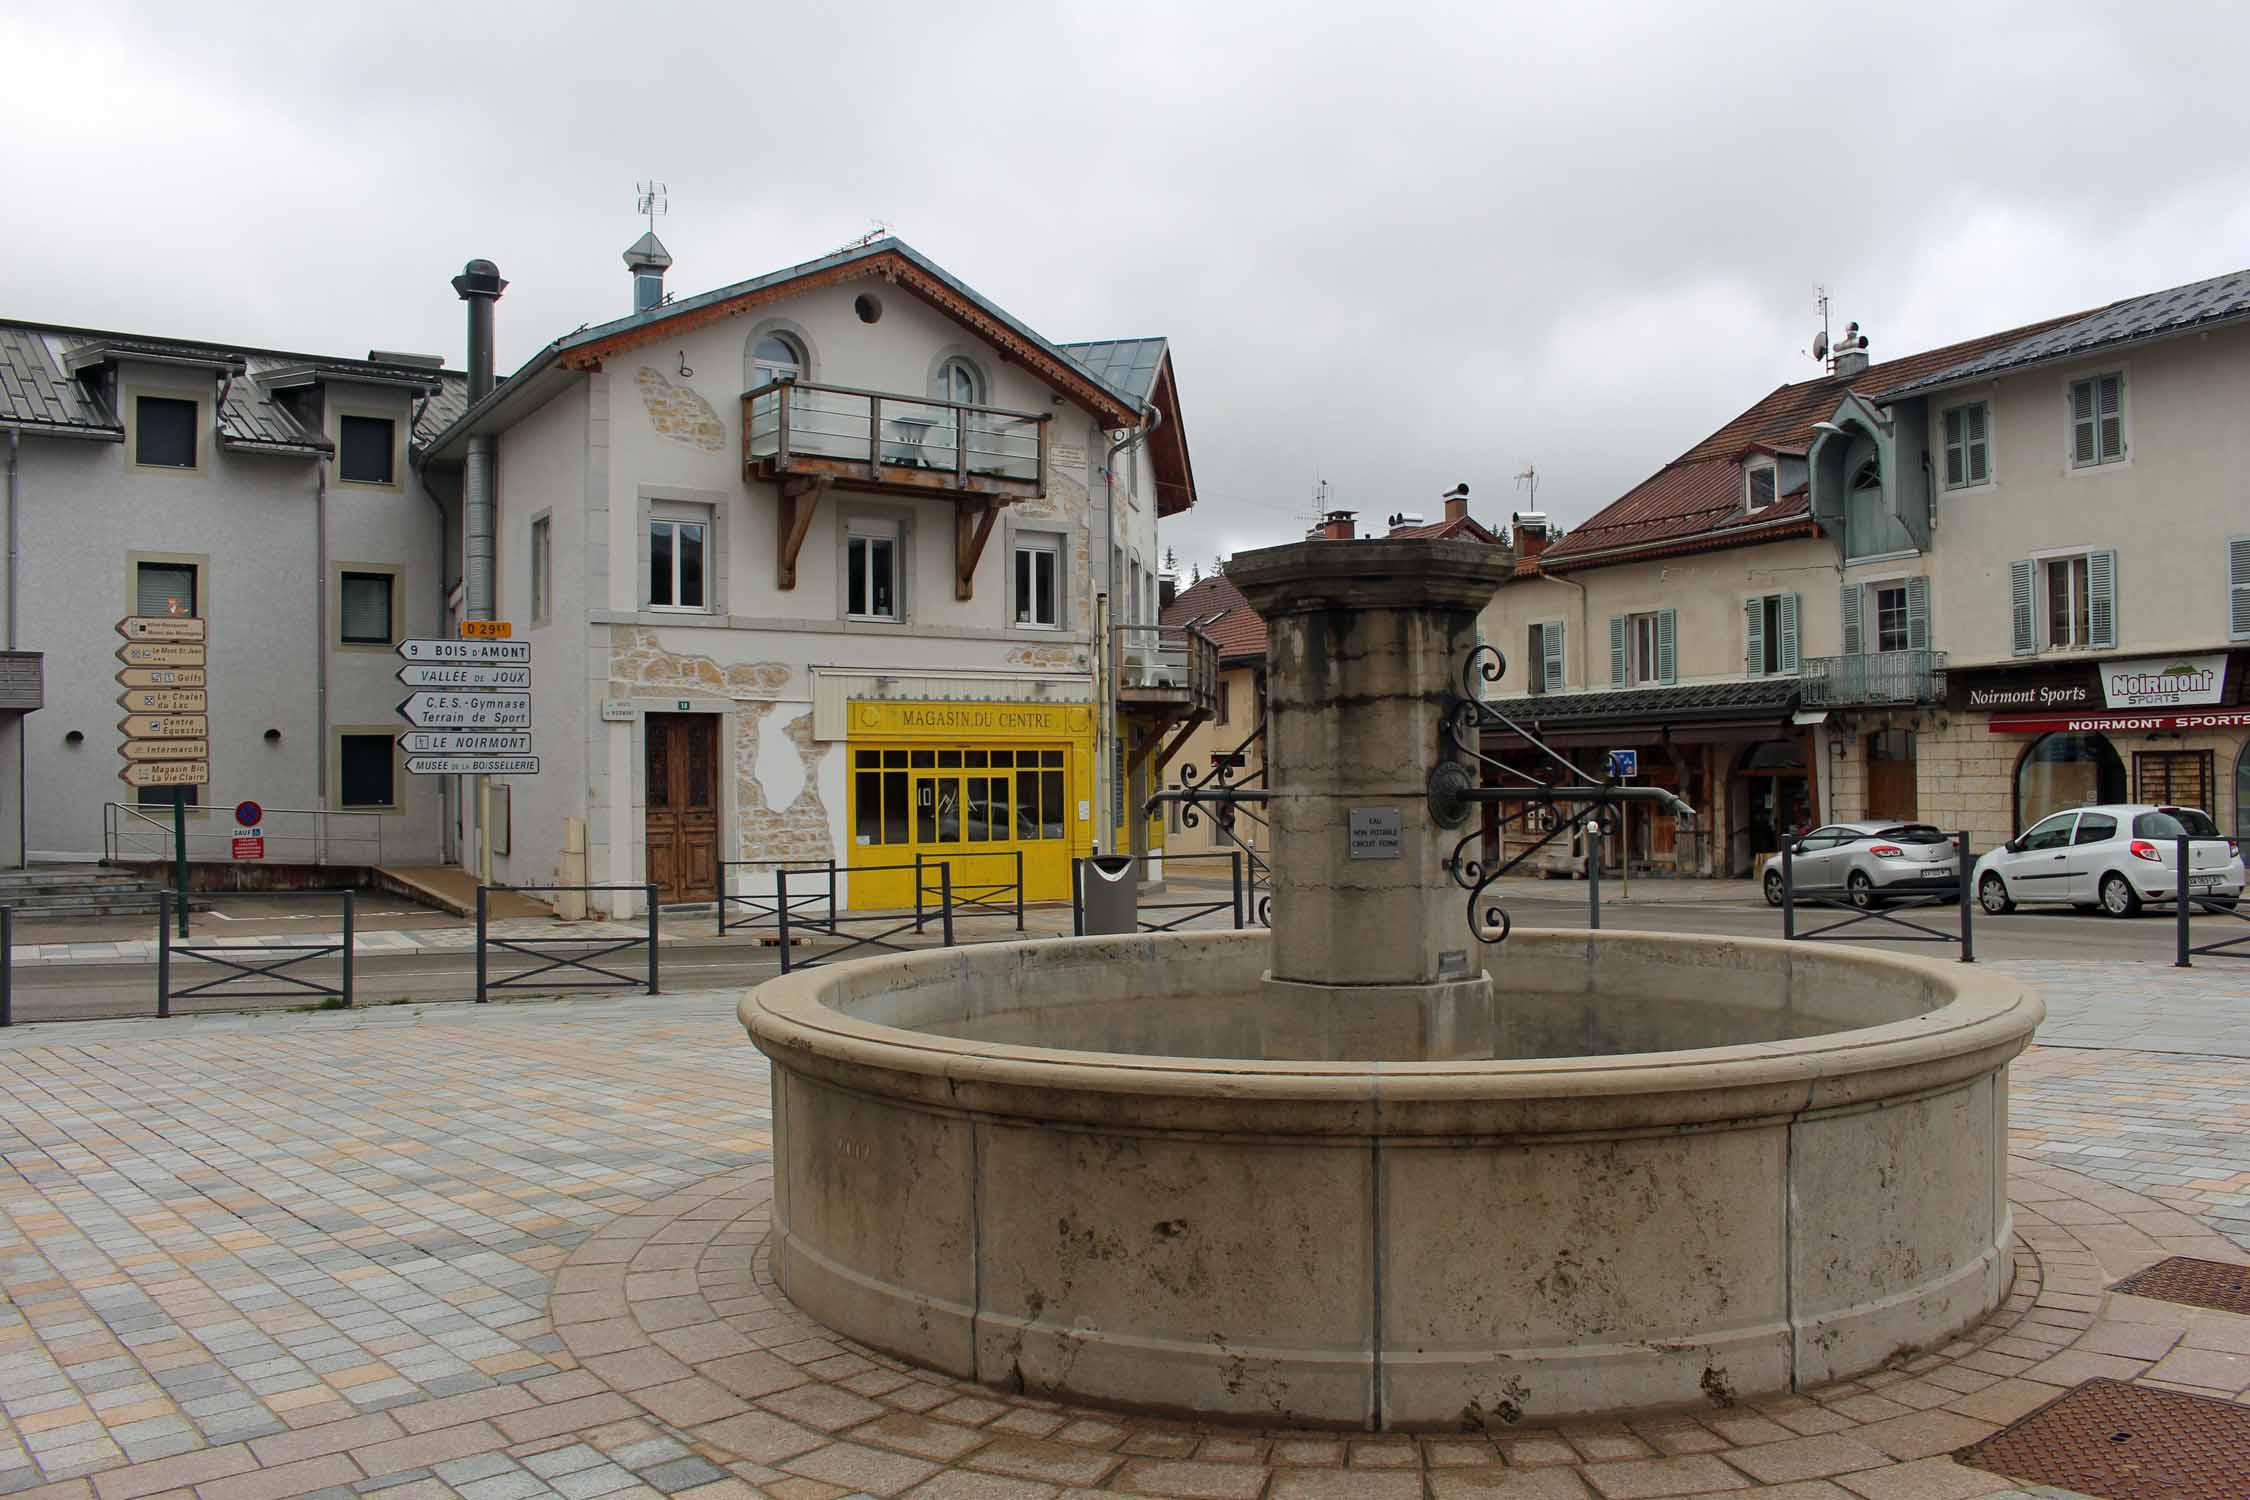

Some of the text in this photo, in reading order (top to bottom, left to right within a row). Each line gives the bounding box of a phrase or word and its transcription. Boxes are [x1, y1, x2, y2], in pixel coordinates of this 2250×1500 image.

[468, 624, 474, 634] D
[411, 645, 418, 655] 9
[436, 646, 467, 656] BOIS
[474, 674, 484, 682] DE
[492, 672, 525, 682] JOUX
[1970, 686, 2086, 706] Noirmont Sports
[2128, 694, 2180, 704] SPORTS
[164, 718, 194, 726] Centre
[422, 712, 526, 724] Terrain de Sport
[903, 711, 1051, 728] MAGASIN DU CENTRE
[2068, 715, 2250, 730] NOIRMONT SPORTS
[433, 737, 526, 748] LE NOIRMONT
[152, 765, 204, 774] Magasin Bio
[416, 760, 448, 770] MUSÉE
[473, 761, 535, 770] BOISSELLERIE
[152, 774, 162, 782] La
[164, 774, 176, 782] Vie
